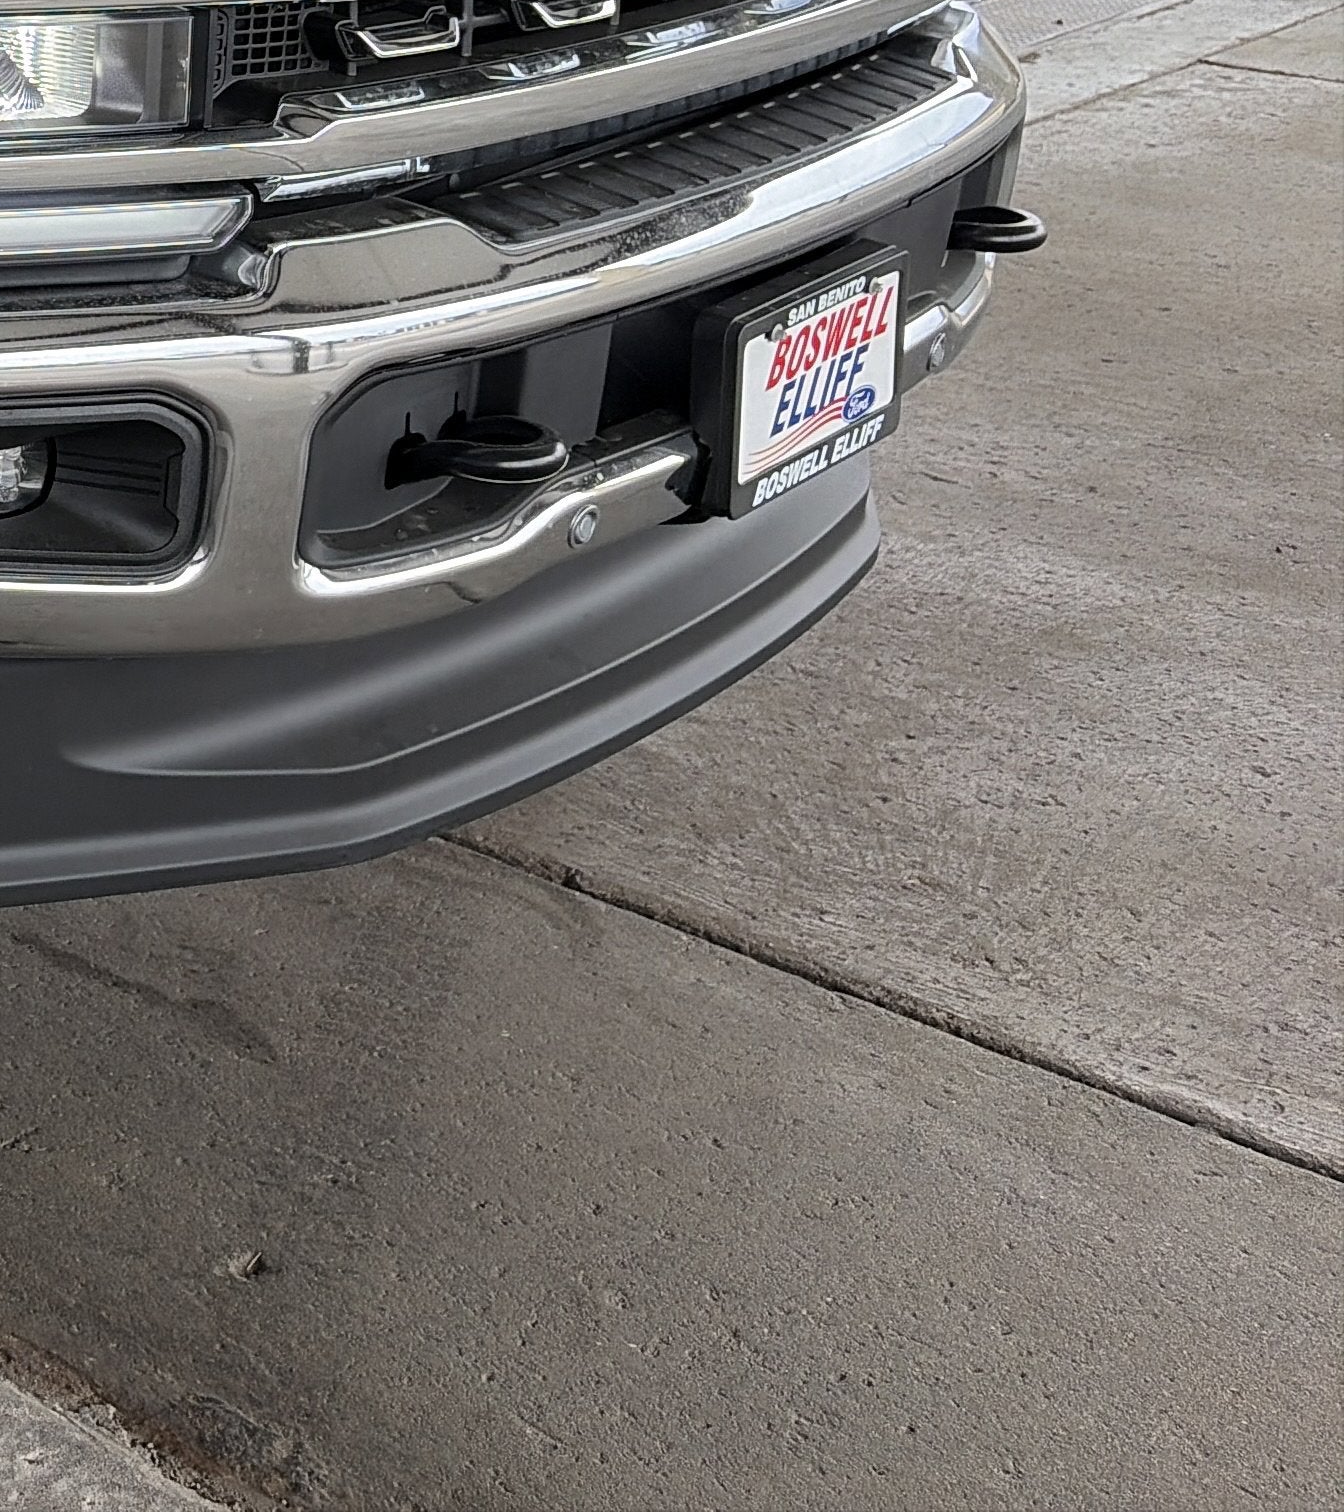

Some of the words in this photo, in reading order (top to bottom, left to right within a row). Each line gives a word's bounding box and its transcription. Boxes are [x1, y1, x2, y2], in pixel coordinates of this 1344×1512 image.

[765, 286, 894, 391] BOSWELL
[787, 298, 817, 327] SAN
[817, 275, 867, 313] BENITO
[769, 343, 870, 438] ELLIFF
[752, 443, 828, 508] BOSWELL
[831, 413, 885, 467] ELLIFF
